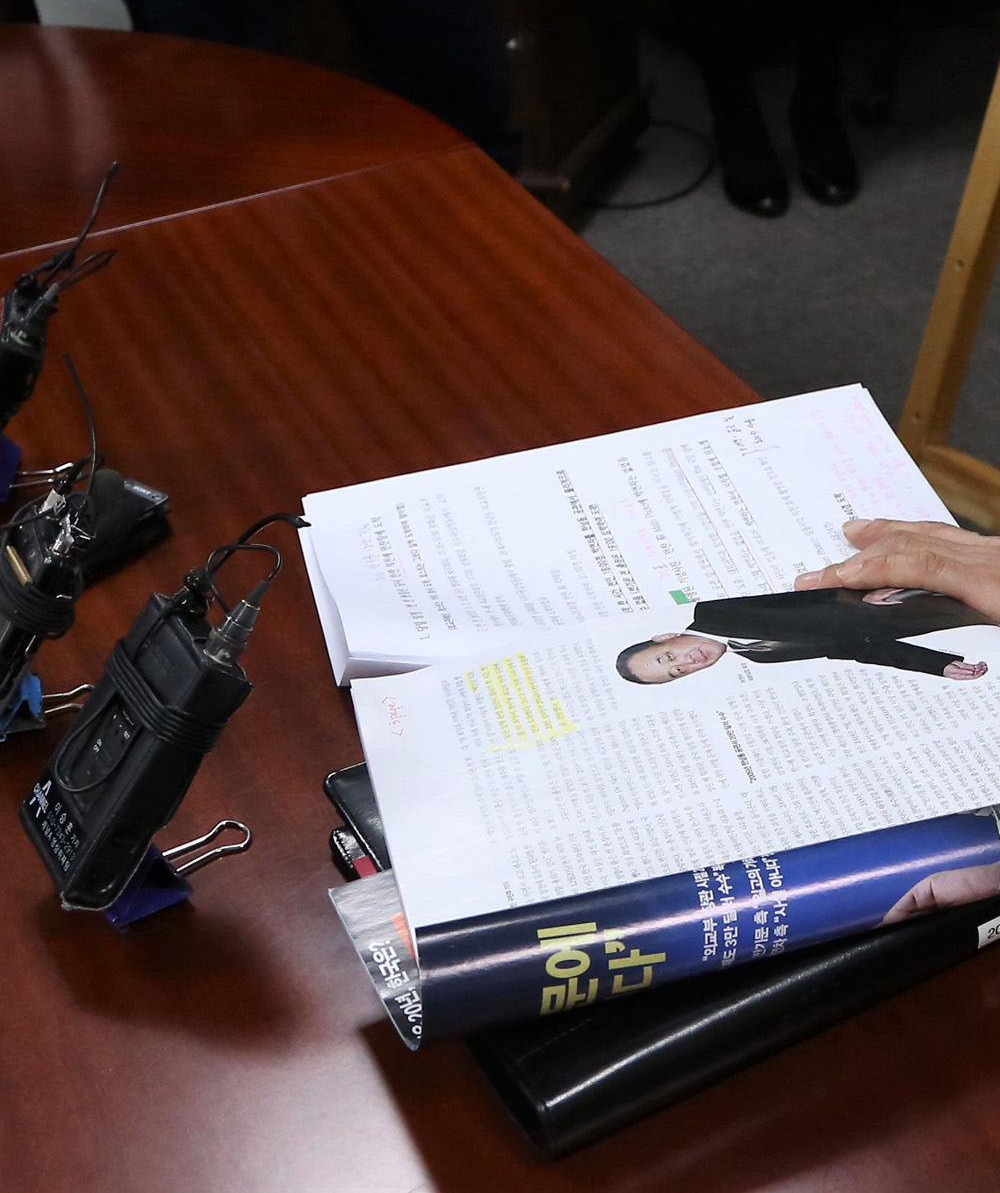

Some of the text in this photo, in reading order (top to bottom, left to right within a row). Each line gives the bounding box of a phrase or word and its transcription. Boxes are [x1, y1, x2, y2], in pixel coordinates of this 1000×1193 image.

[753, 910, 768, 924] 측
[723, 926, 738, 947] 3만
[773, 924, 788, 936] 측
[367, 939, 410, 989] 한국은?
